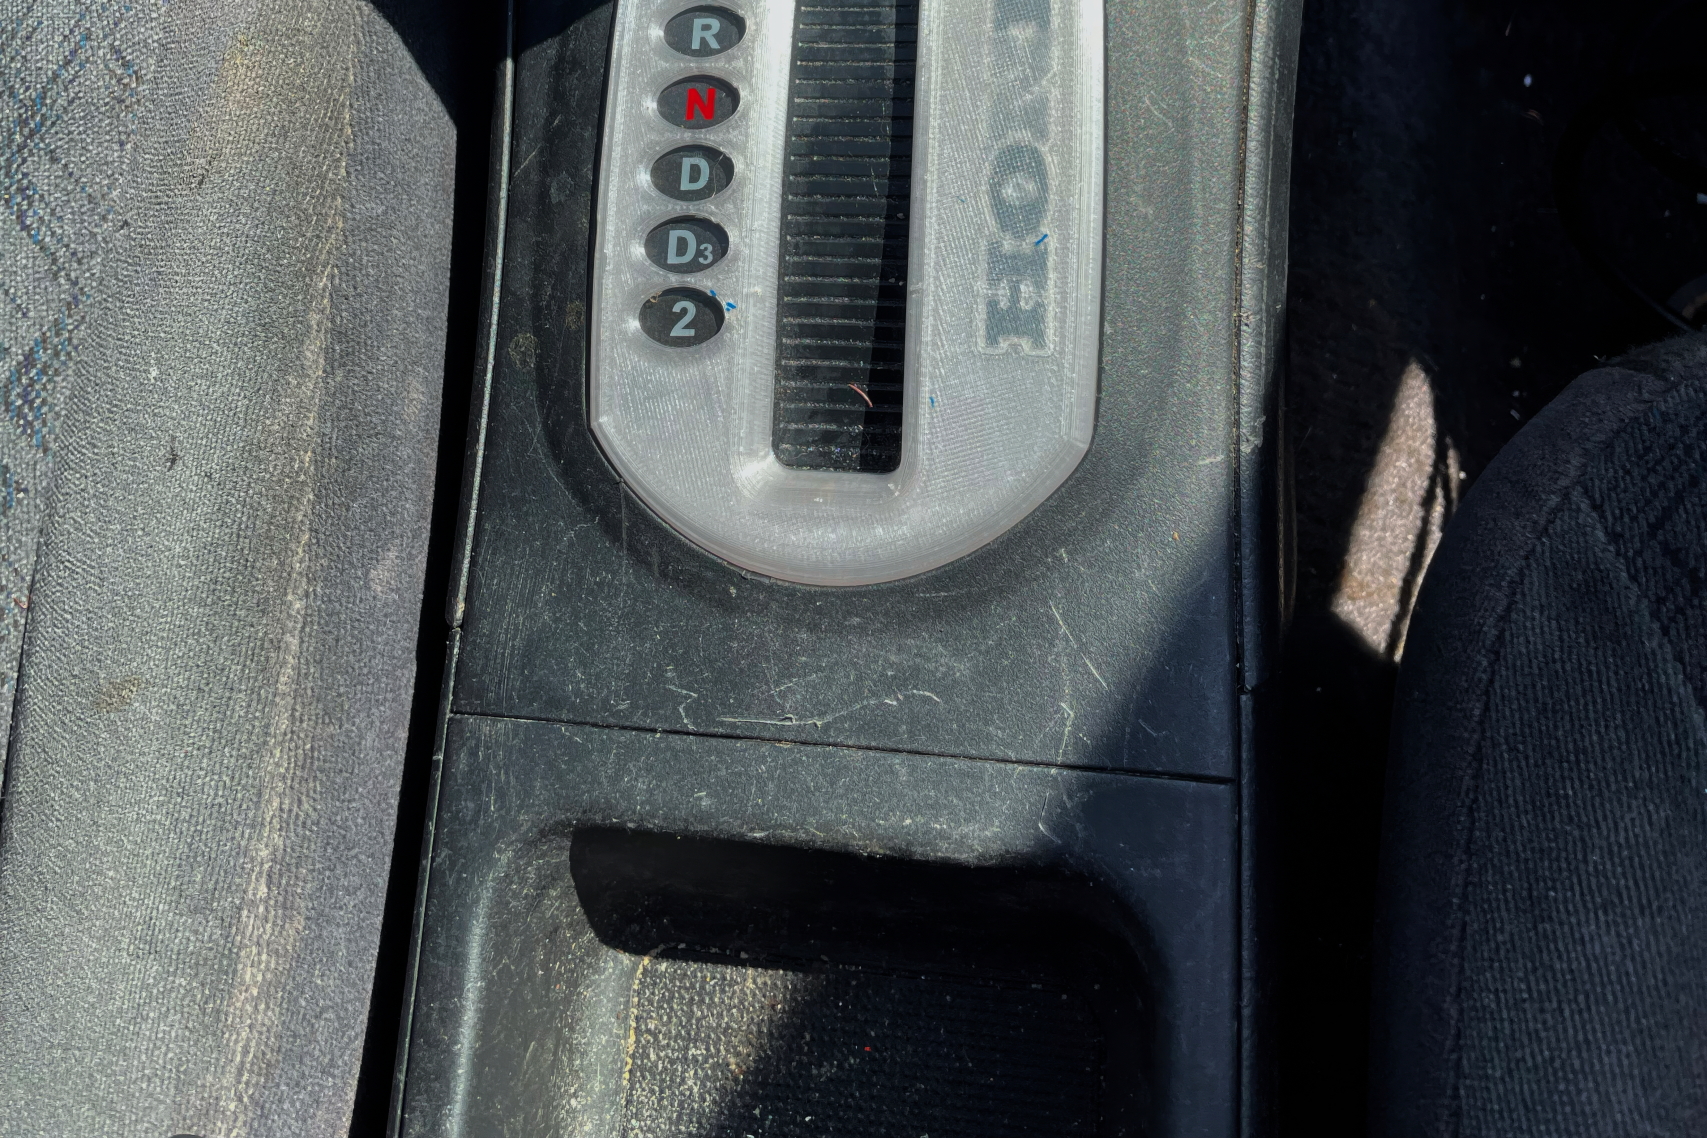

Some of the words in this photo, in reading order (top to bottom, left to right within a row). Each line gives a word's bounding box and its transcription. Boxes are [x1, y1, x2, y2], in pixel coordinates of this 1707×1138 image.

[691, 18, 720, 50] R
[685, 88, 716, 120] N
[679, 157, 709, 191] D
[669, 301, 696, 337] 2
